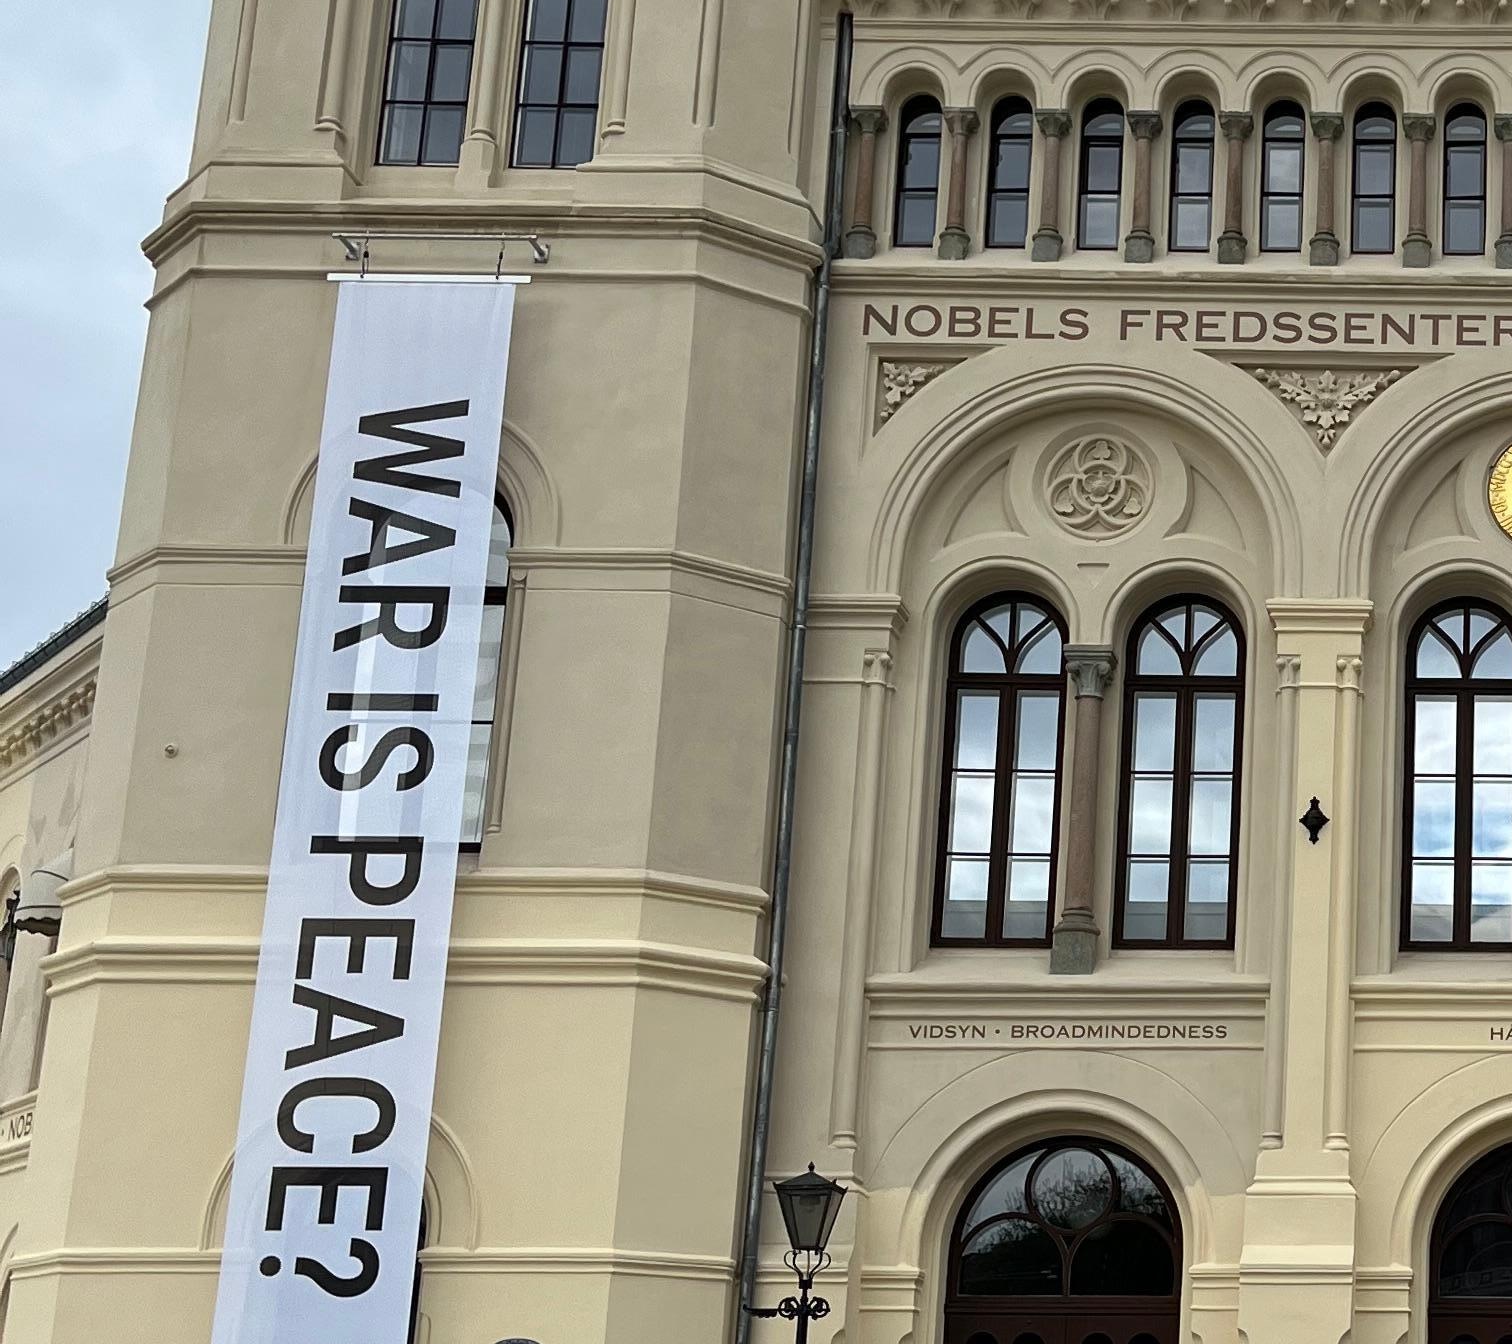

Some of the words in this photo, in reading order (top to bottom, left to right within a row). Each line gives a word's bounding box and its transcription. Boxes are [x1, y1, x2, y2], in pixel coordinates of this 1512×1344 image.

[862, 304, 1090, 341] NOBELS
[332, 399, 470, 653] WAR
[318, 692, 440, 791] IS
[259, 835, 425, 1298] PEACE?
[909, 1024, 987, 1039] VIDSYN
[1010, 1024, 1228, 1040] BROADMINDEDNESS
